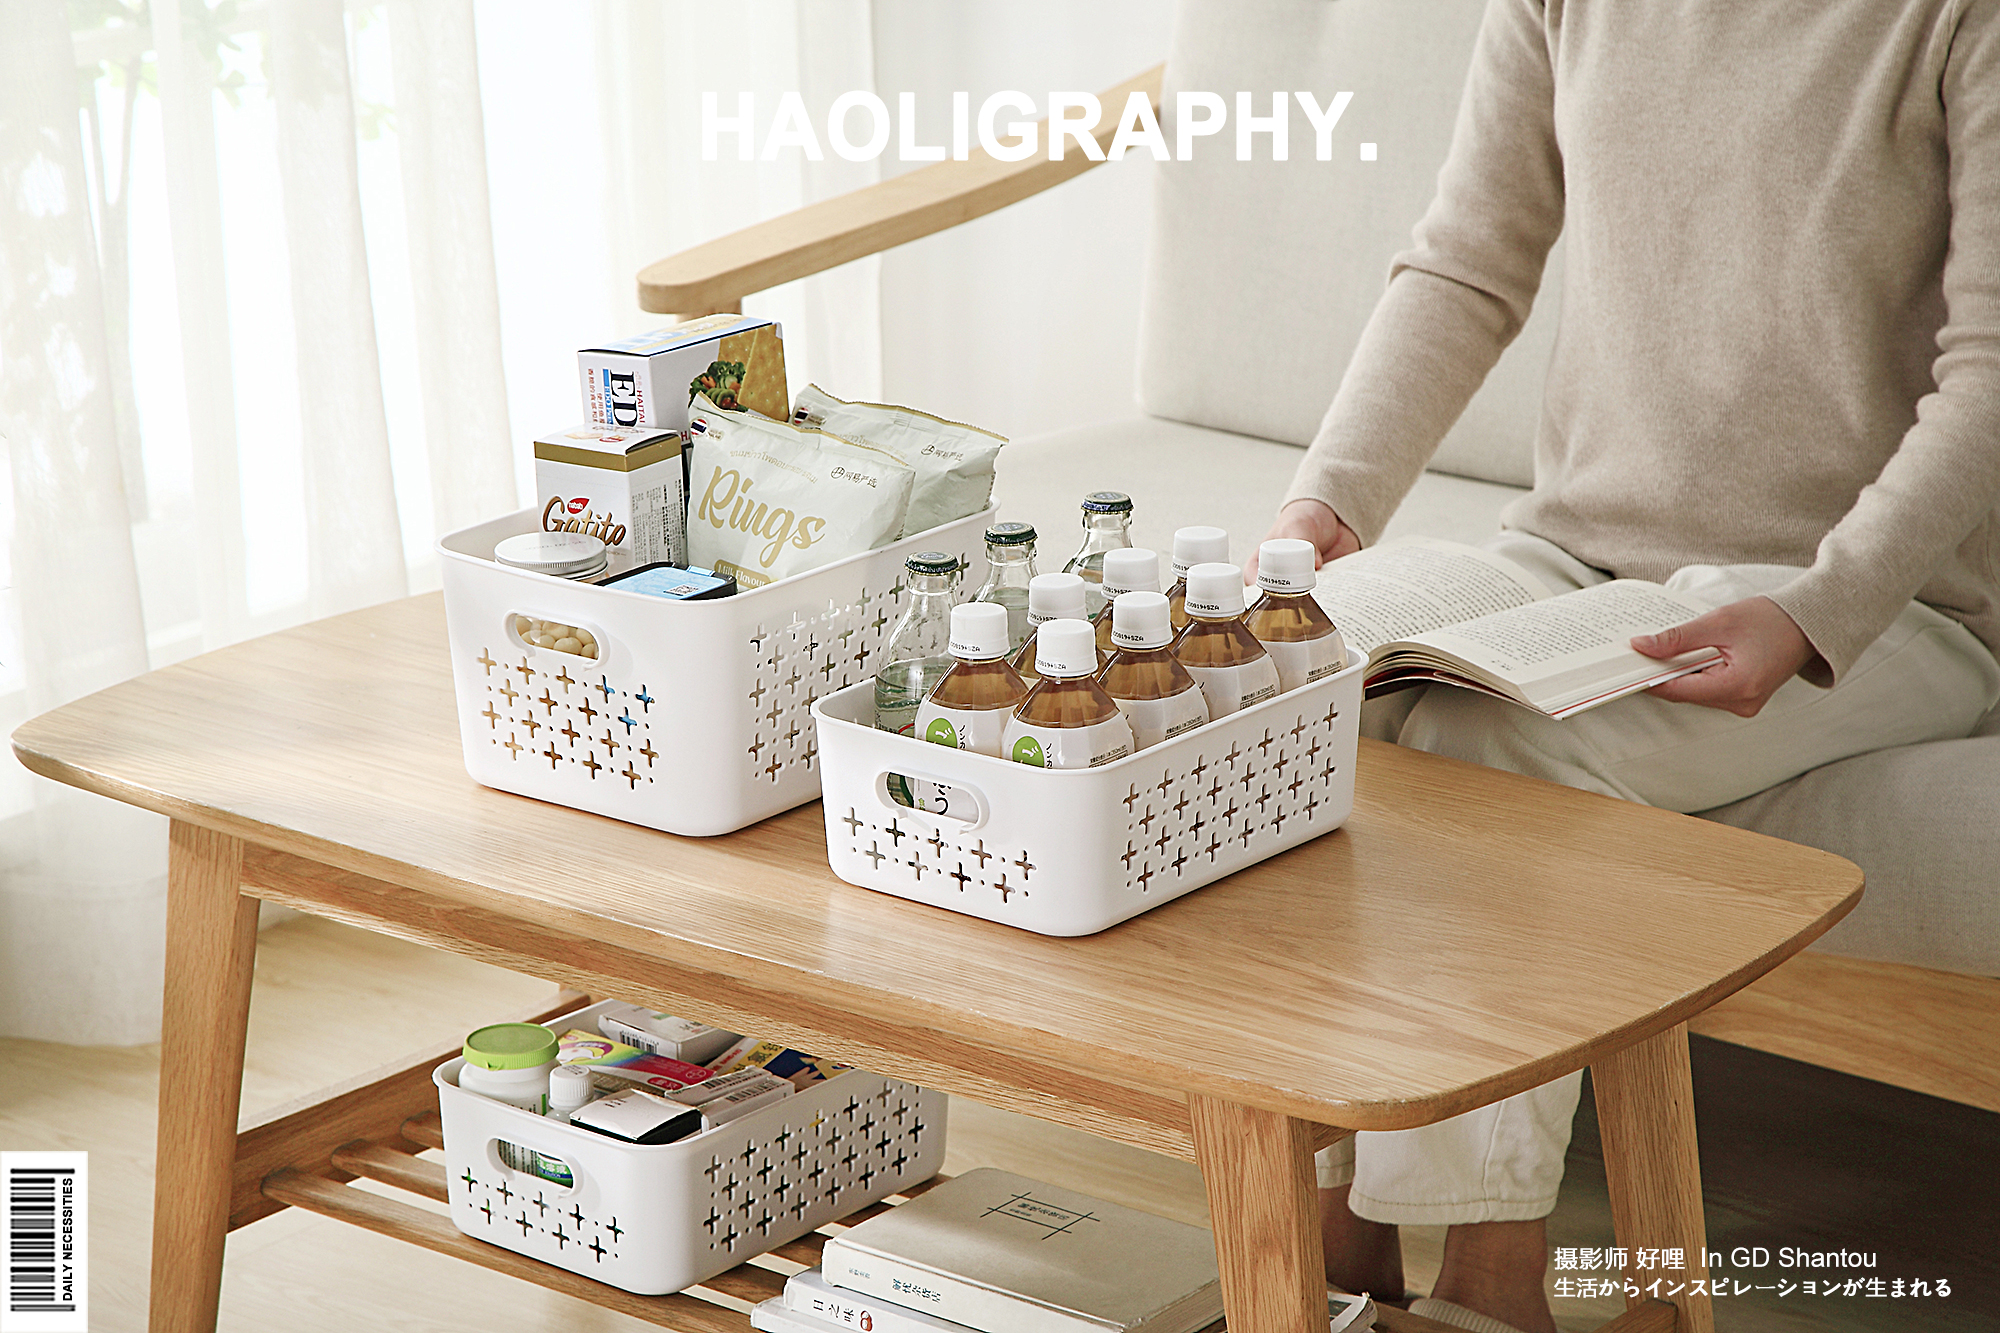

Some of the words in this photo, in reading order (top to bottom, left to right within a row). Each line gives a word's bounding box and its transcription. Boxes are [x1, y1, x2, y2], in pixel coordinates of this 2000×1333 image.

[636, 390, 646, 423] HAITAI
[542, 495, 627, 547] Gatito
[698, 465, 827, 568] Rings
[717, 563, 735, 577] Milk
[892, 1278, 941, 1304] 解忧杂货店
